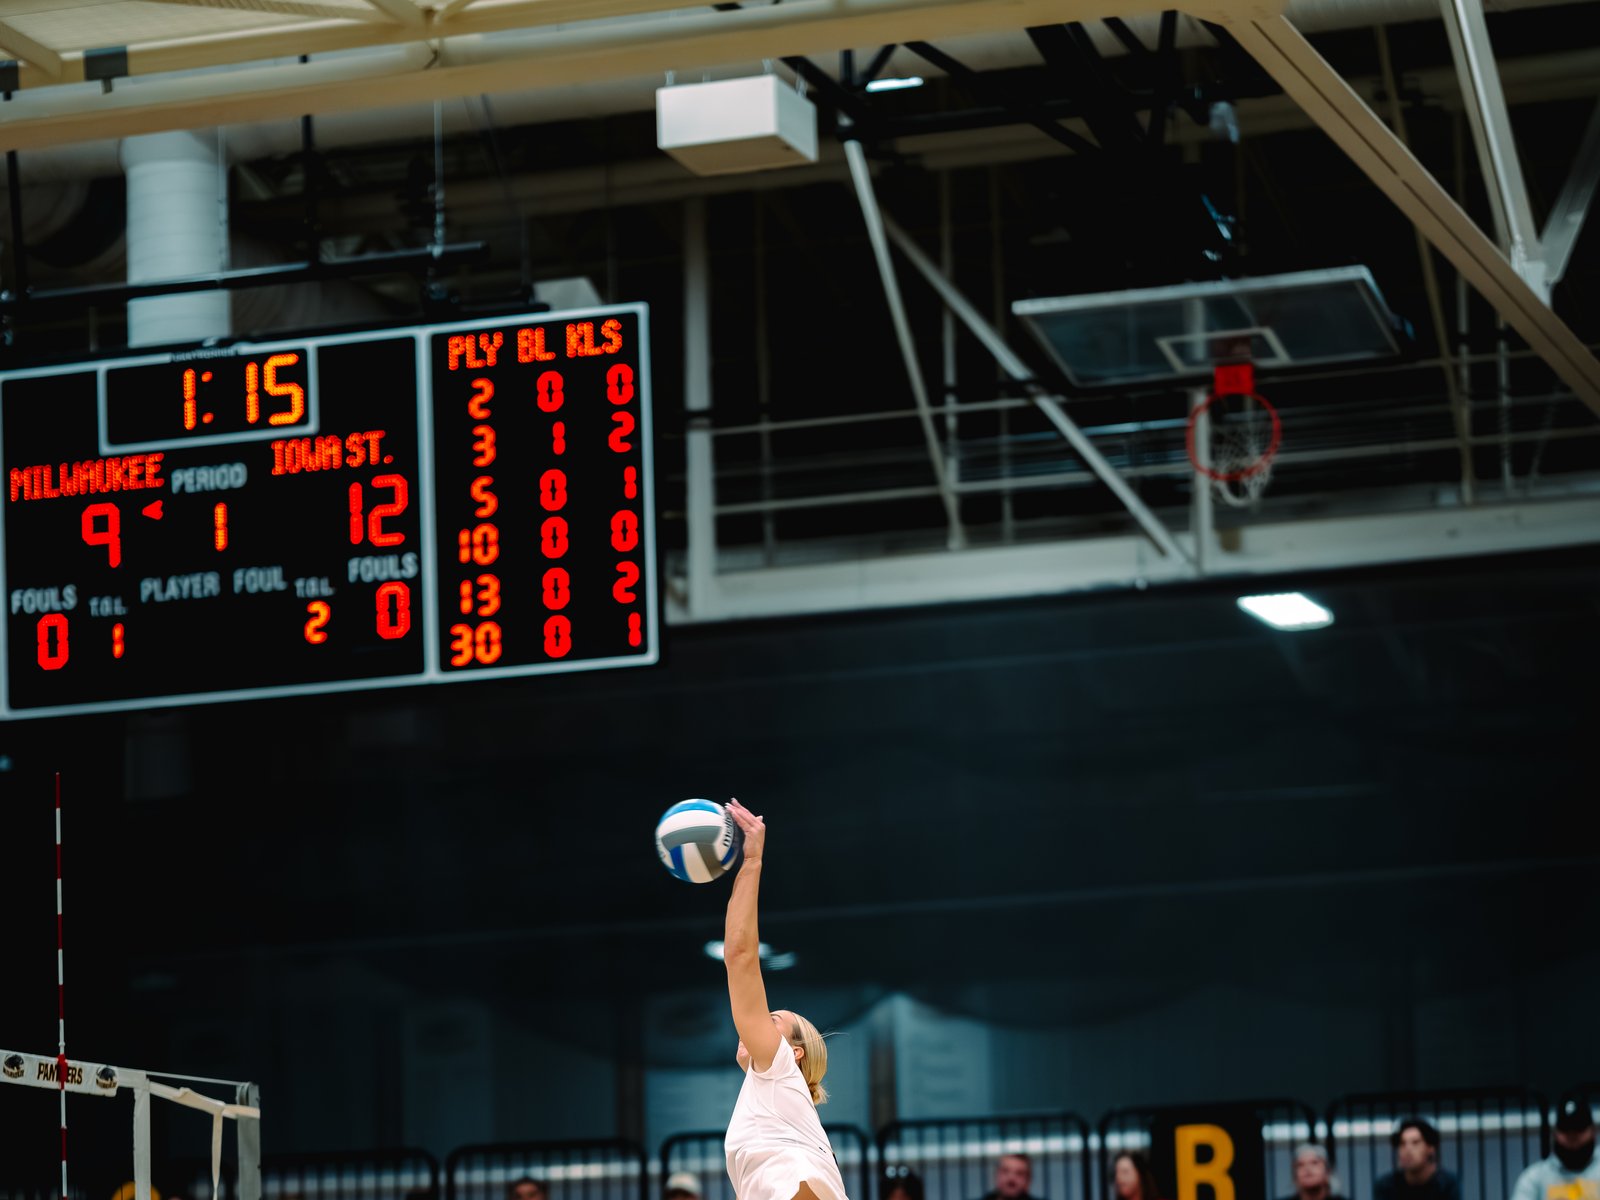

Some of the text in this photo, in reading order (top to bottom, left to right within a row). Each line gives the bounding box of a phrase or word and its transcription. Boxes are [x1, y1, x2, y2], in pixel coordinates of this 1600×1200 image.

[448, 318, 623, 371] PLY BL KLS
[468, 363, 634, 420] 2 0 0
[271, 434, 343, 476] IOWA
[472, 411, 635, 468] 3 1 2
[10, 452, 165, 502] MILWAUKEE
[171, 462, 248, 495] PERIOD
[470, 466, 637, 518] 5 0 1
[81, 502, 121, 569] 9
[214, 502, 228, 551] 1
[349, 473, 409, 547] 12
[458, 509, 639, 566] 10 0 0
[140, 565, 288, 603] PLAYER FOUL
[348, 552, 419, 583] FOULS
[459, 561, 640, 617] 13 0 2
[11, 583, 78, 615] FOULS
[304, 600, 331, 645] 2
[376, 581, 411, 640] 0
[37, 613, 69, 670] 0
[112, 623, 125, 659] 1
[450, 612, 641, 667] 30 0 1
[37, 1062, 83, 1085] PANERS
